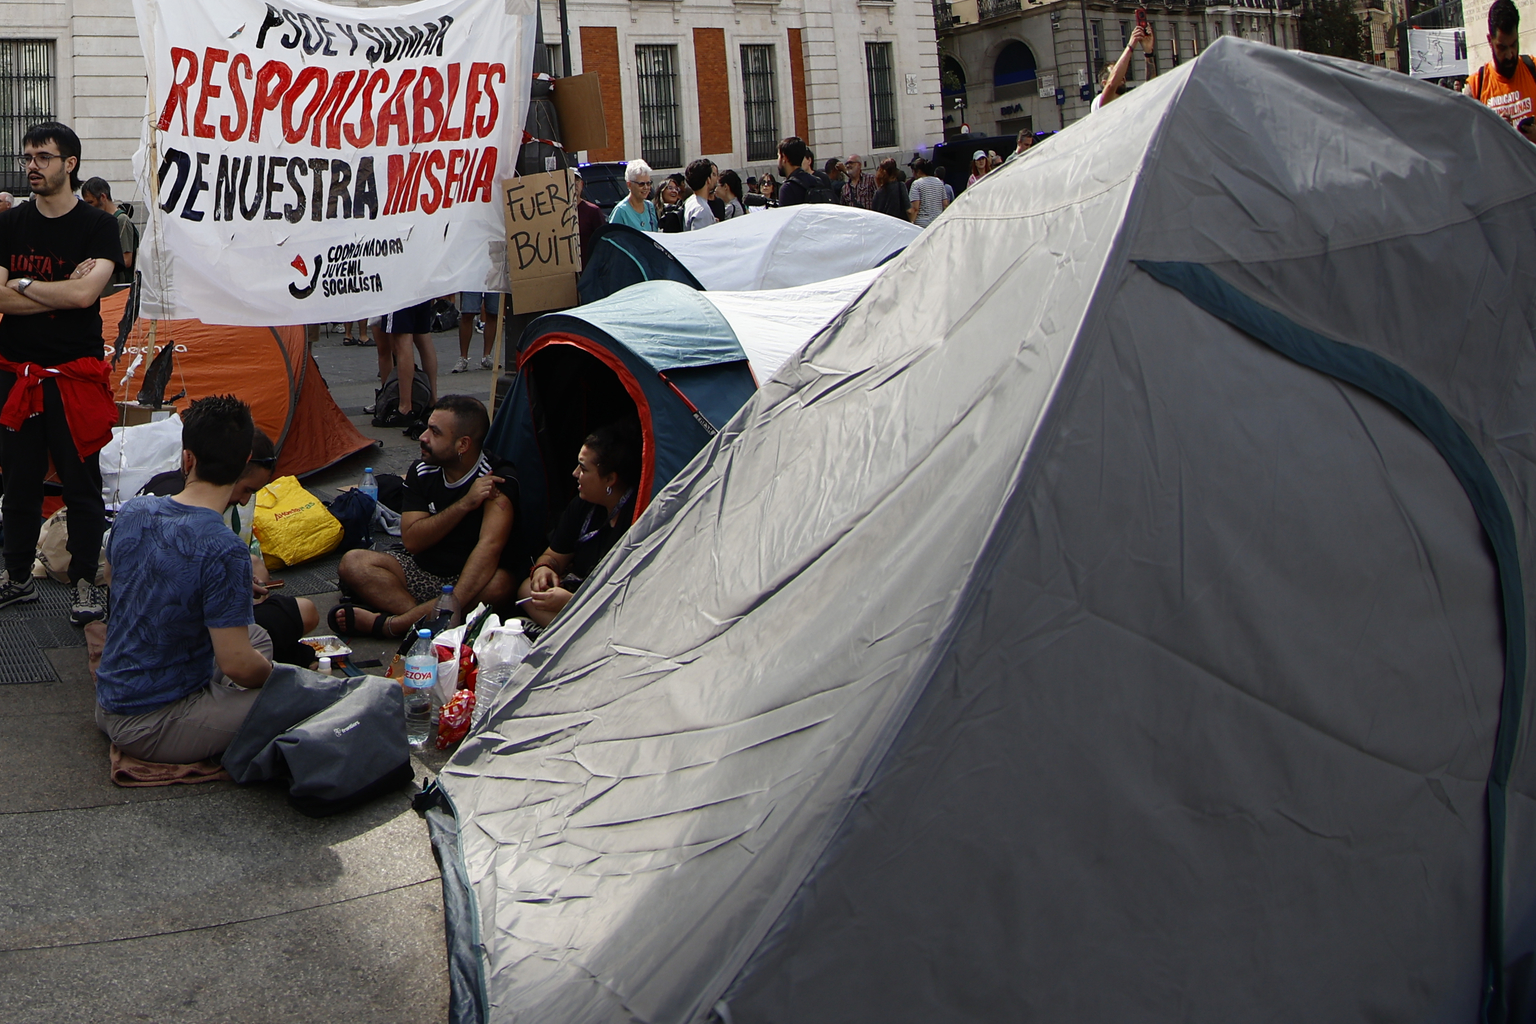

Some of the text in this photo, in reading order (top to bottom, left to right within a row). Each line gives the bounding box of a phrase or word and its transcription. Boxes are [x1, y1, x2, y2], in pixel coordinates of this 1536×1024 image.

[256, 2, 455, 64] PSOE Y SUMAR
[157, 46, 507, 150] RESPONSABLES
[1001, 103, 1024, 116] BBVA
[1486, 90, 1520, 108] SINDICATO
[157, 146, 499, 224] DE NUESTRA MISERIA
[327, 237, 404, 263] COORDINADORA
[10, 254, 52, 274] LOITA
[322, 258, 365, 278] JUVENIL
[322, 273, 383, 298] SOCIALISTA
